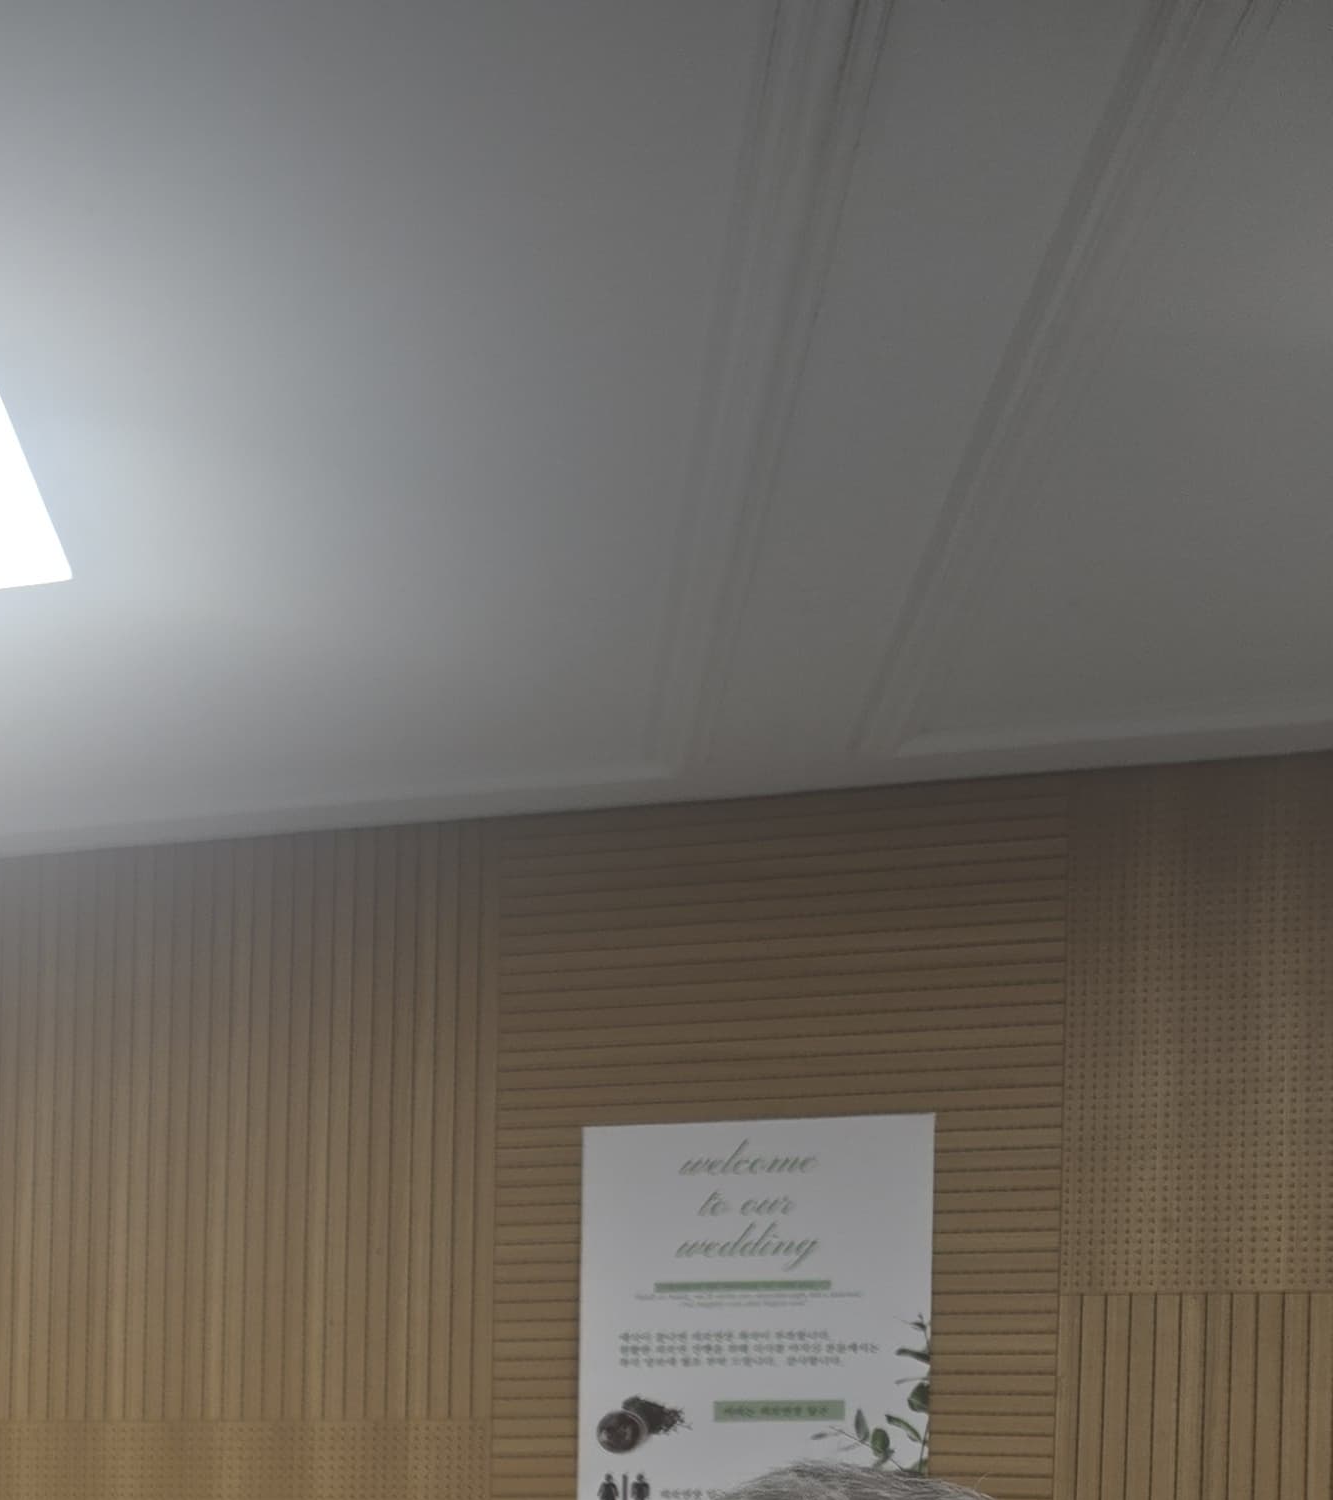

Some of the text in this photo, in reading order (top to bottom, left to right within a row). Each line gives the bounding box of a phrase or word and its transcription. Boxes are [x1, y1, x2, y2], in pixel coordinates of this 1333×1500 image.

[678, 1138, 818, 1176] welcome
[697, 1190, 728, 1217] to
[674, 1221, 820, 1272] wedding
